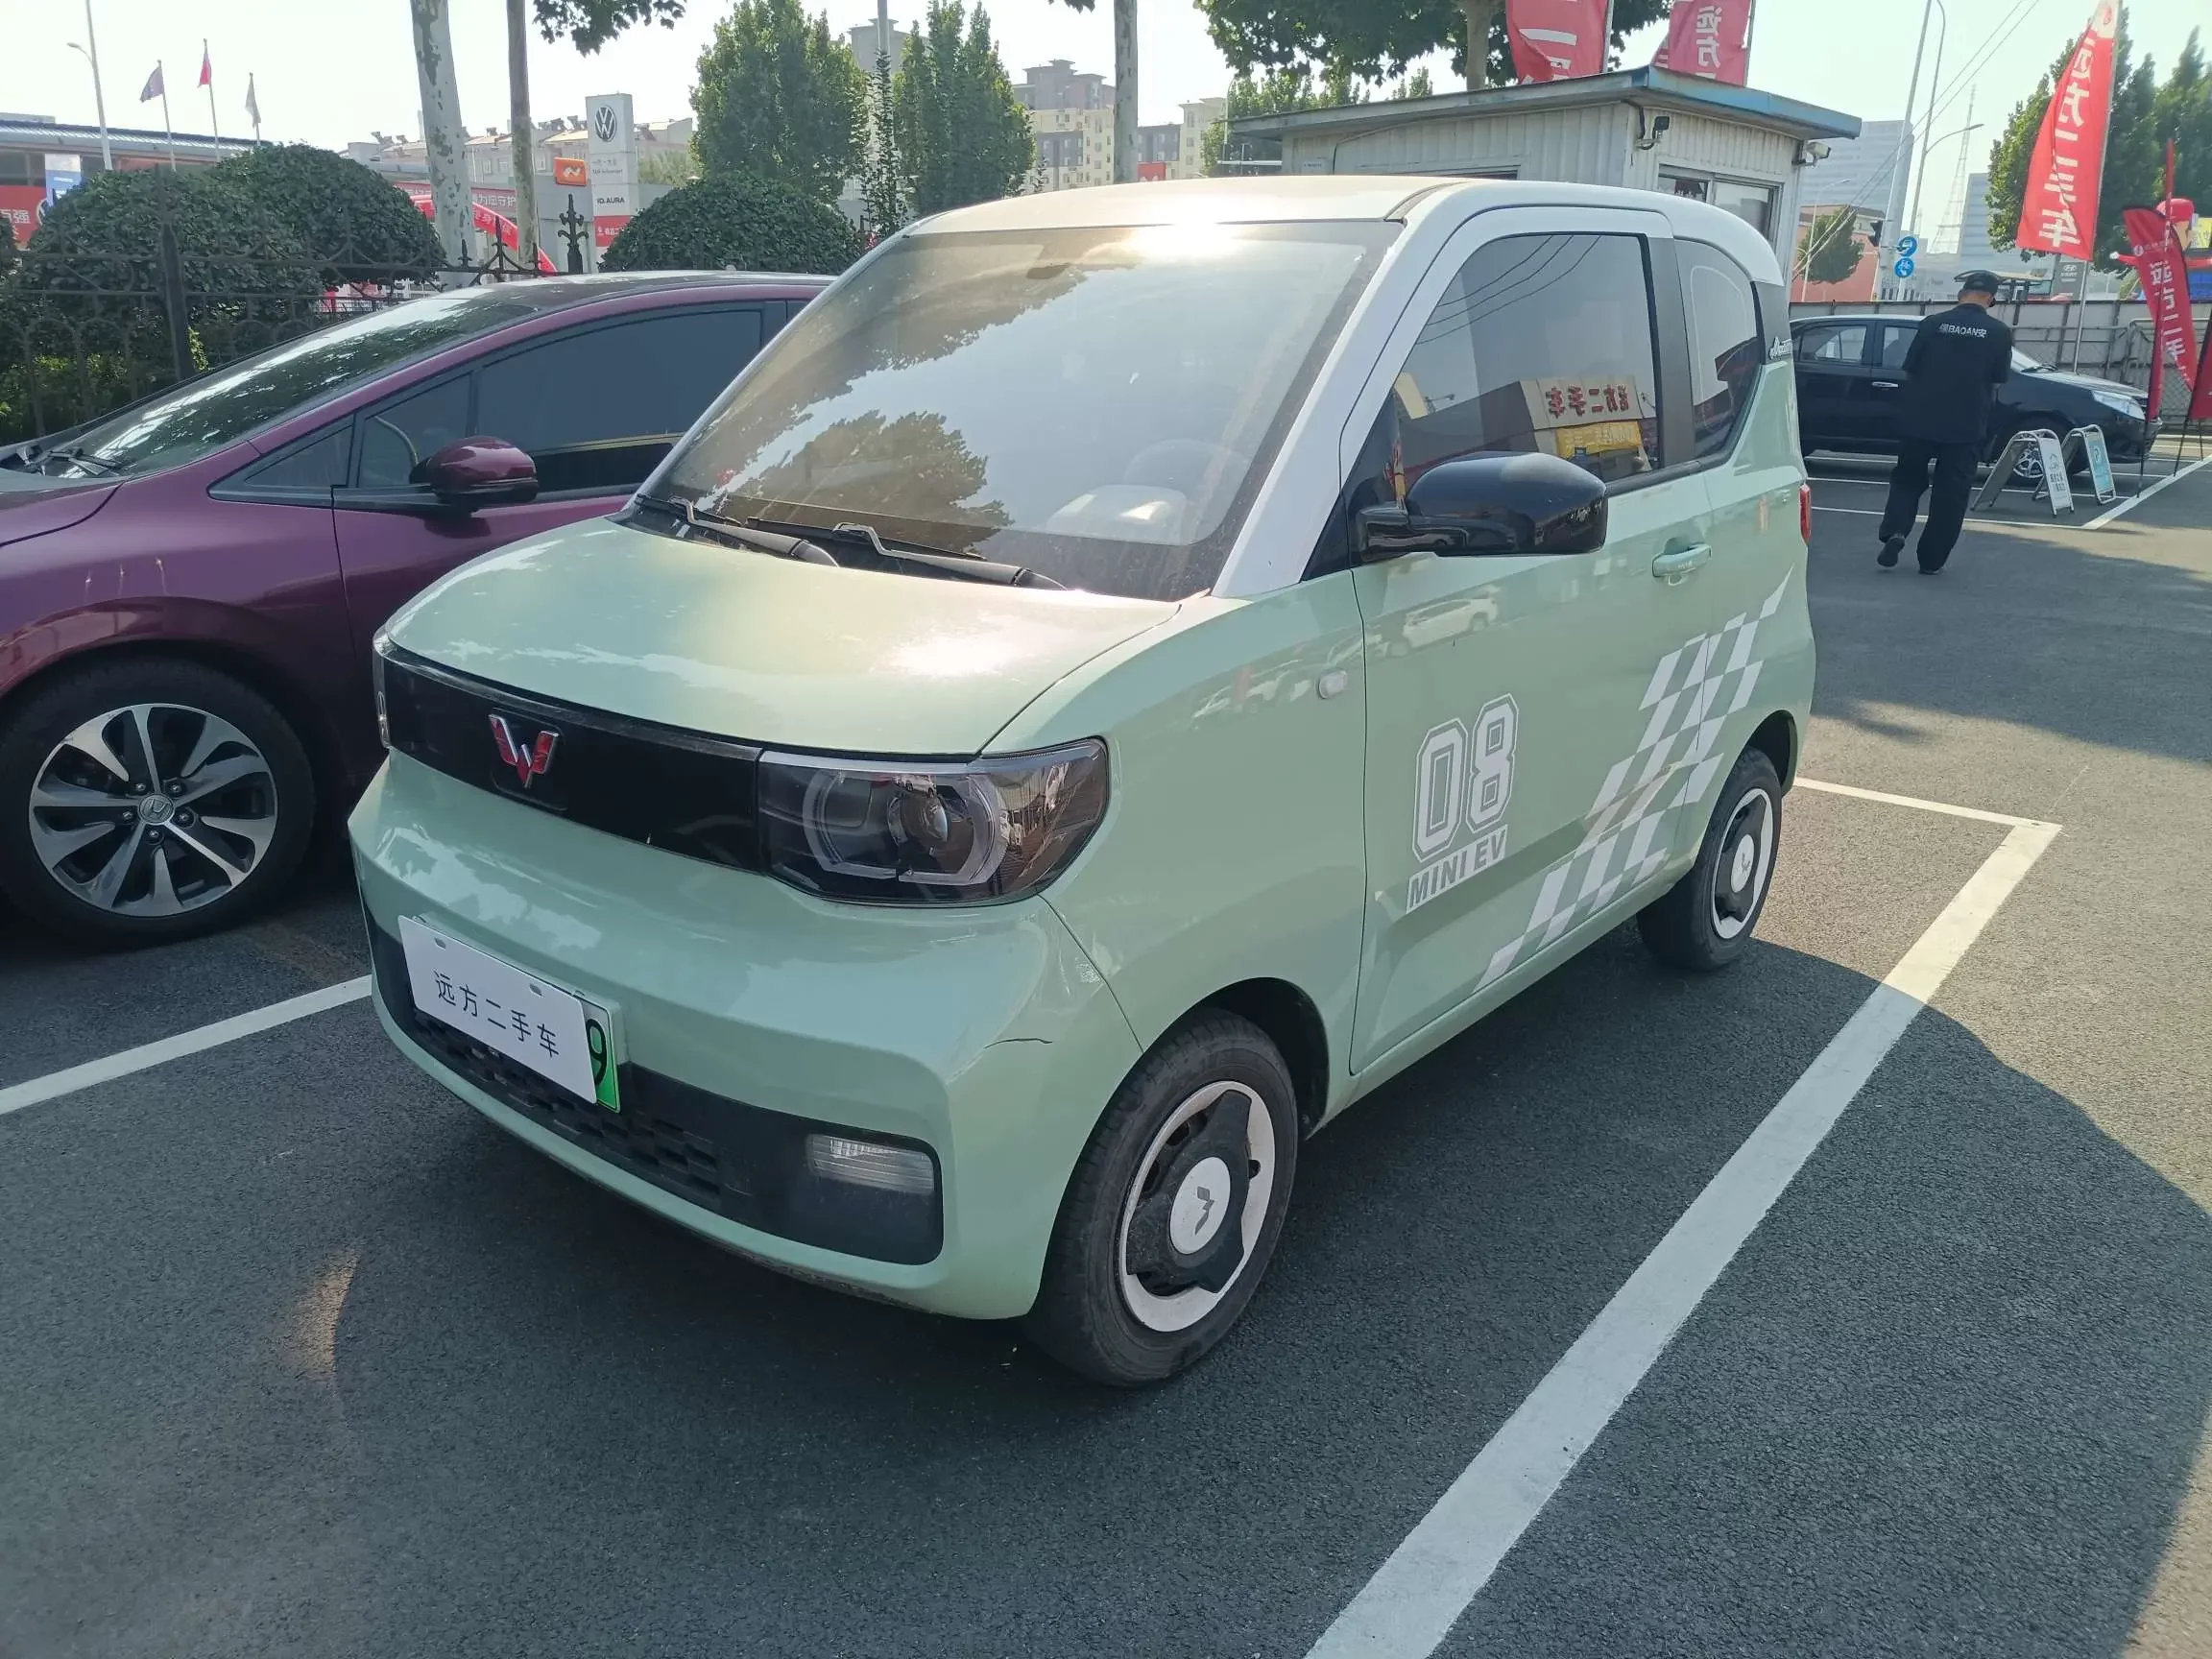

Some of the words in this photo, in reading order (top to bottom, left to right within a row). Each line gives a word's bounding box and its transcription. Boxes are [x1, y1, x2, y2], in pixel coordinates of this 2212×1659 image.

[1412, 692, 1519, 863] 08
[1408, 849, 1469, 911] MINI
[1473, 827, 1506, 873] EV
[434, 970, 560, 1059] 远方二手车
